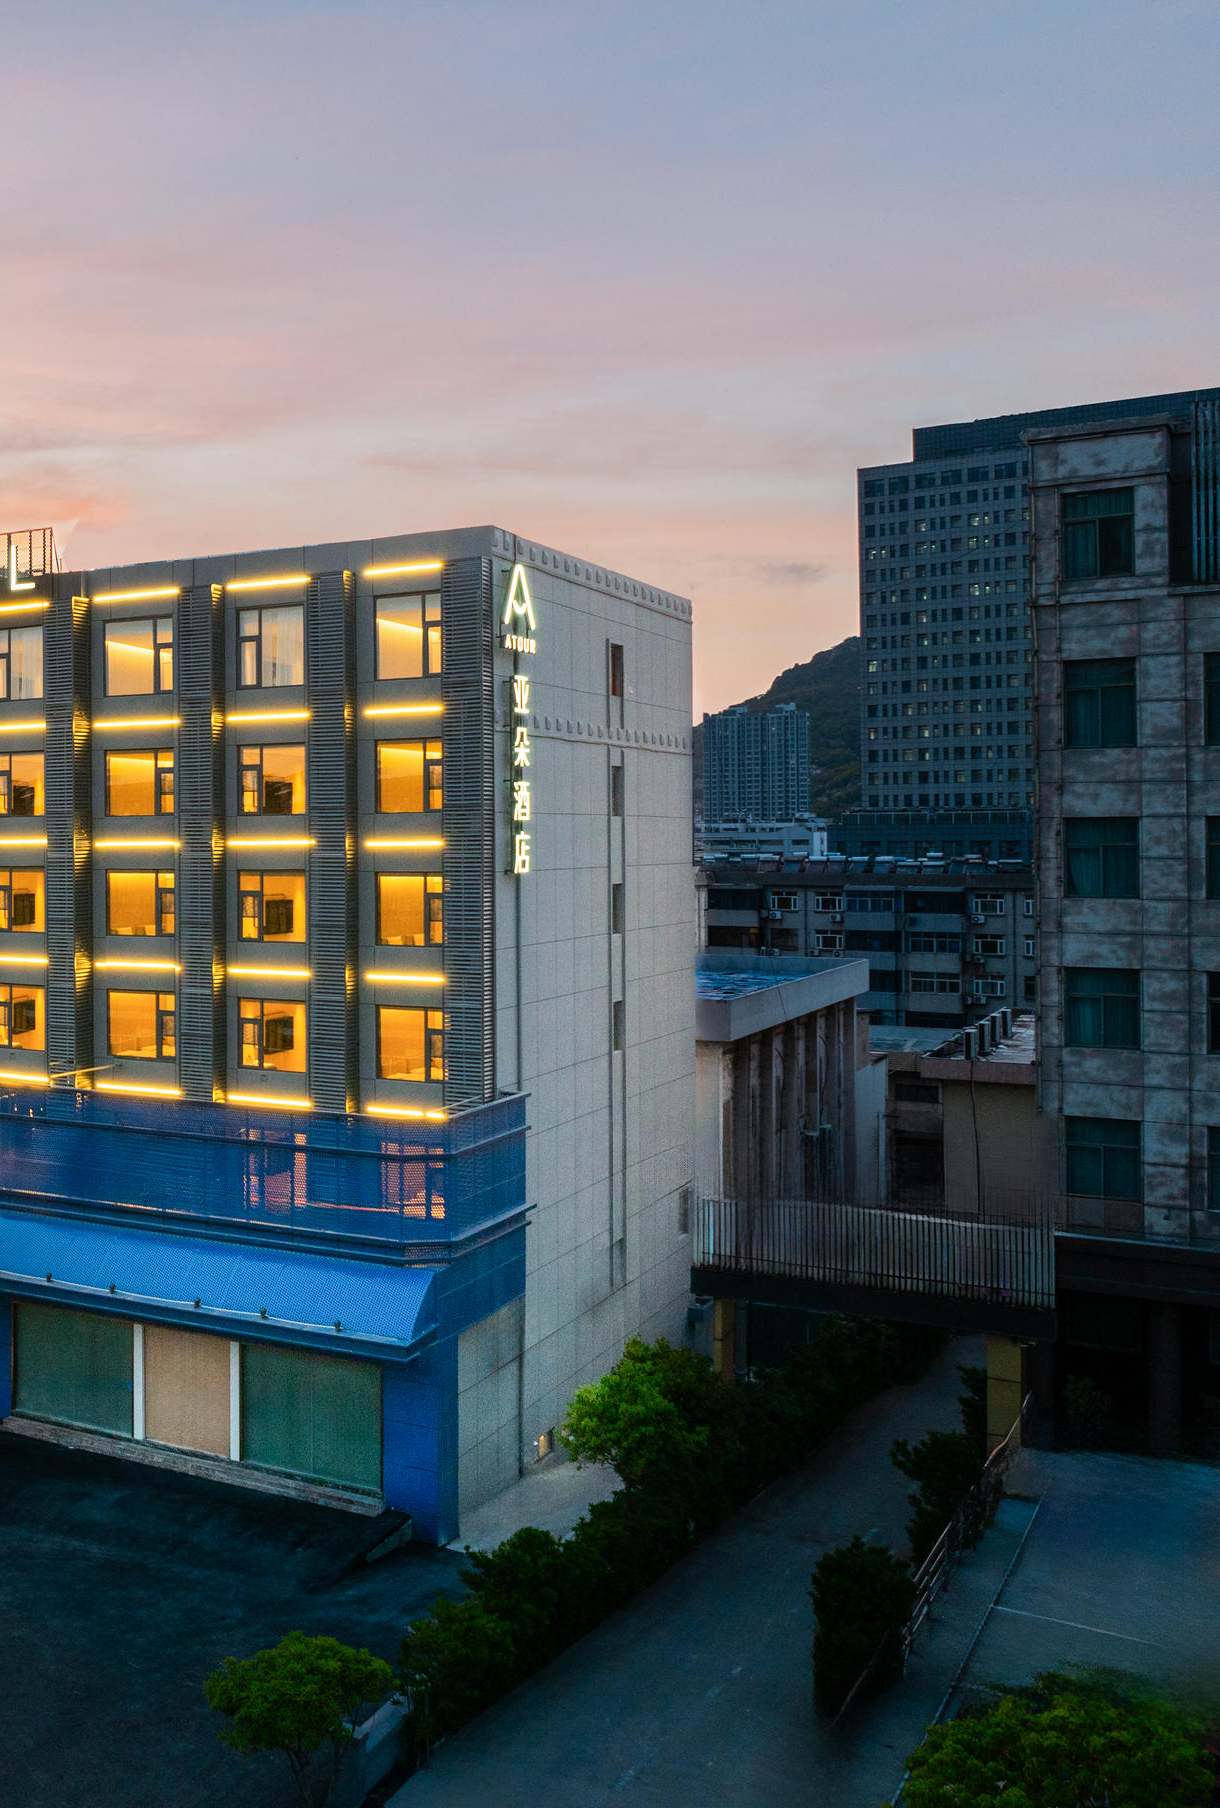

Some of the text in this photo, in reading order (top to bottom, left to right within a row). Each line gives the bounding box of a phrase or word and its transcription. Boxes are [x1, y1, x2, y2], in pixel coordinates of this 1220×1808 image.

[504, 633, 537, 654] ATOUR
[513, 674, 531, 875] 亚朵酒店
